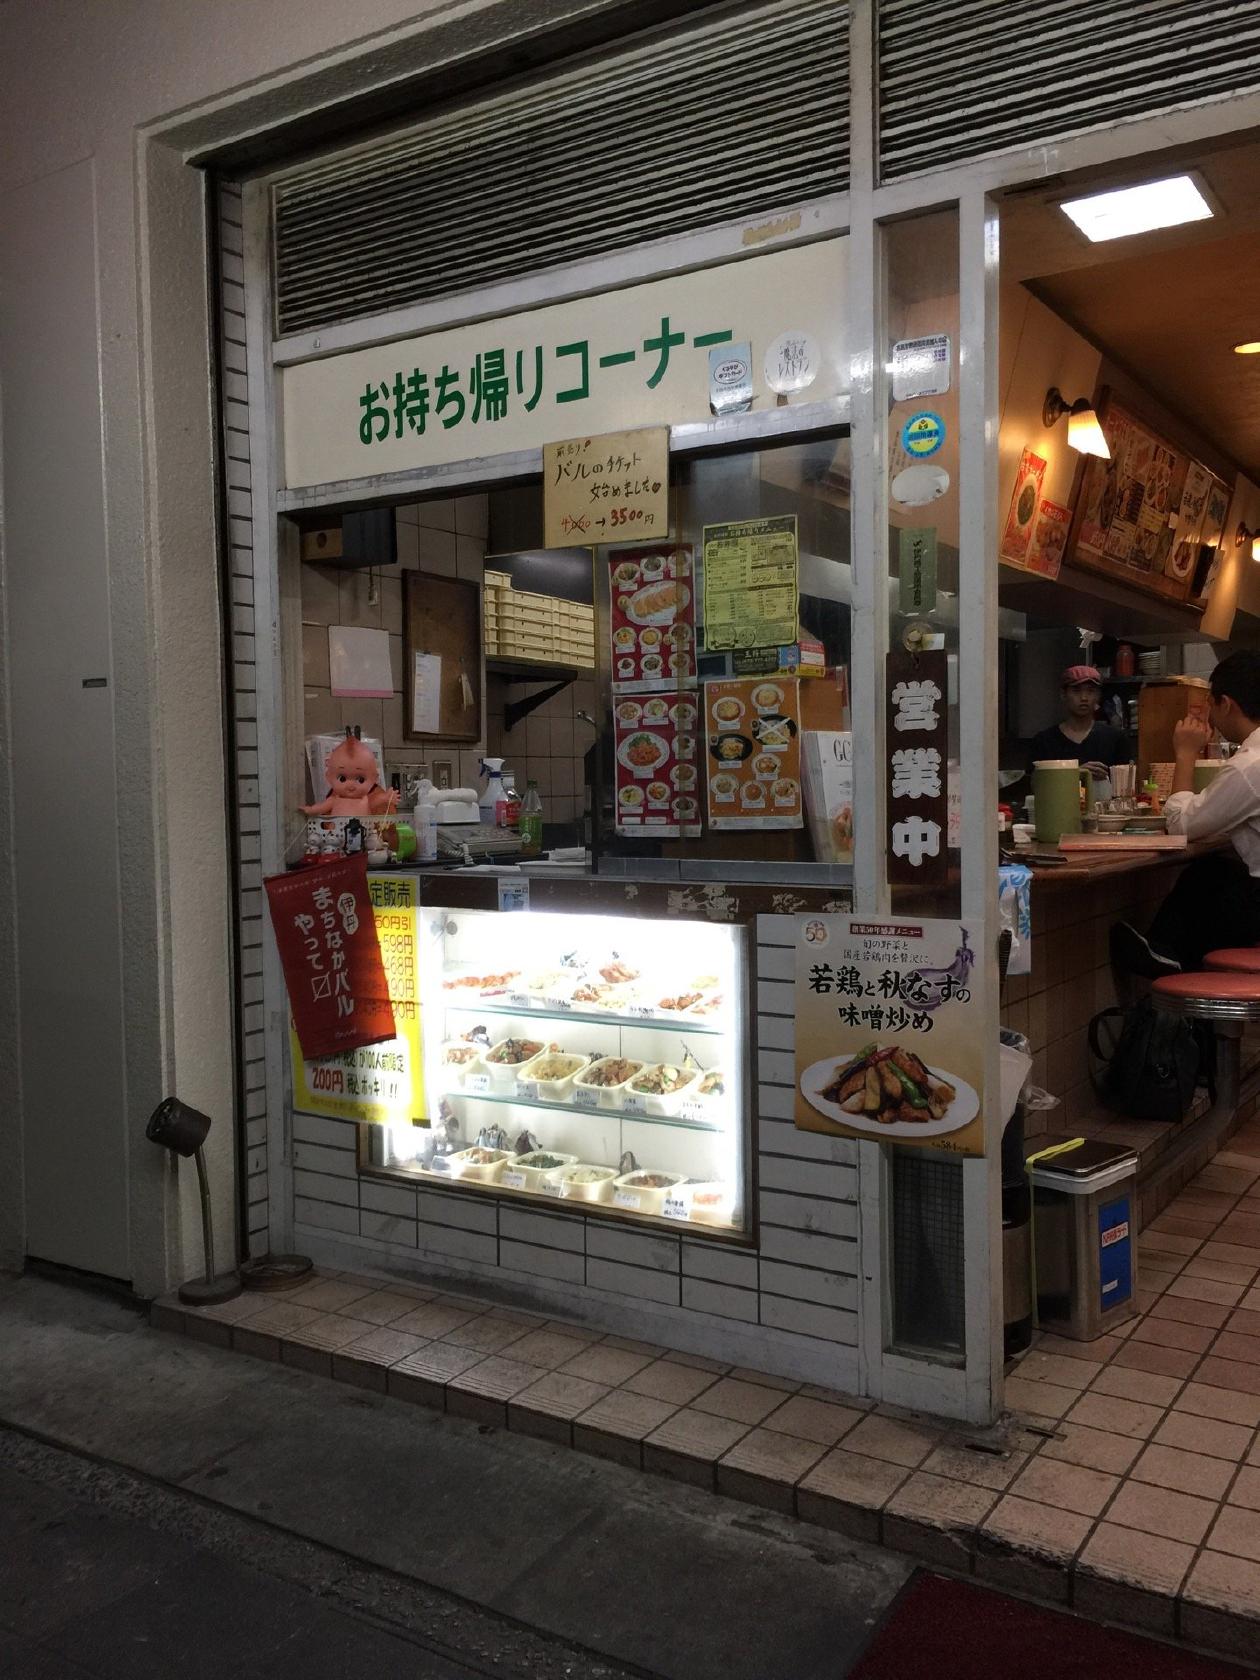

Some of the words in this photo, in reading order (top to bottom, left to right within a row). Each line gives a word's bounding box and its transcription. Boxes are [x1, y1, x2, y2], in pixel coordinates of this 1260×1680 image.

[359, 316, 733, 446] お持ち帰りコーナー
[554, 452, 642, 486] バルのチケット
[610, 507, 655, 527] 3500円
[891, 679, 942, 867] 営業中
[341, 896, 358, 931] 伊丹
[313, 886, 355, 1017] まちなかバル
[863, 939, 908, 951] 旬の野菜と
[808, 963, 971, 1004] 若鶏と秋なすの
[838, 1002, 934, 1033] 味噌炒め
